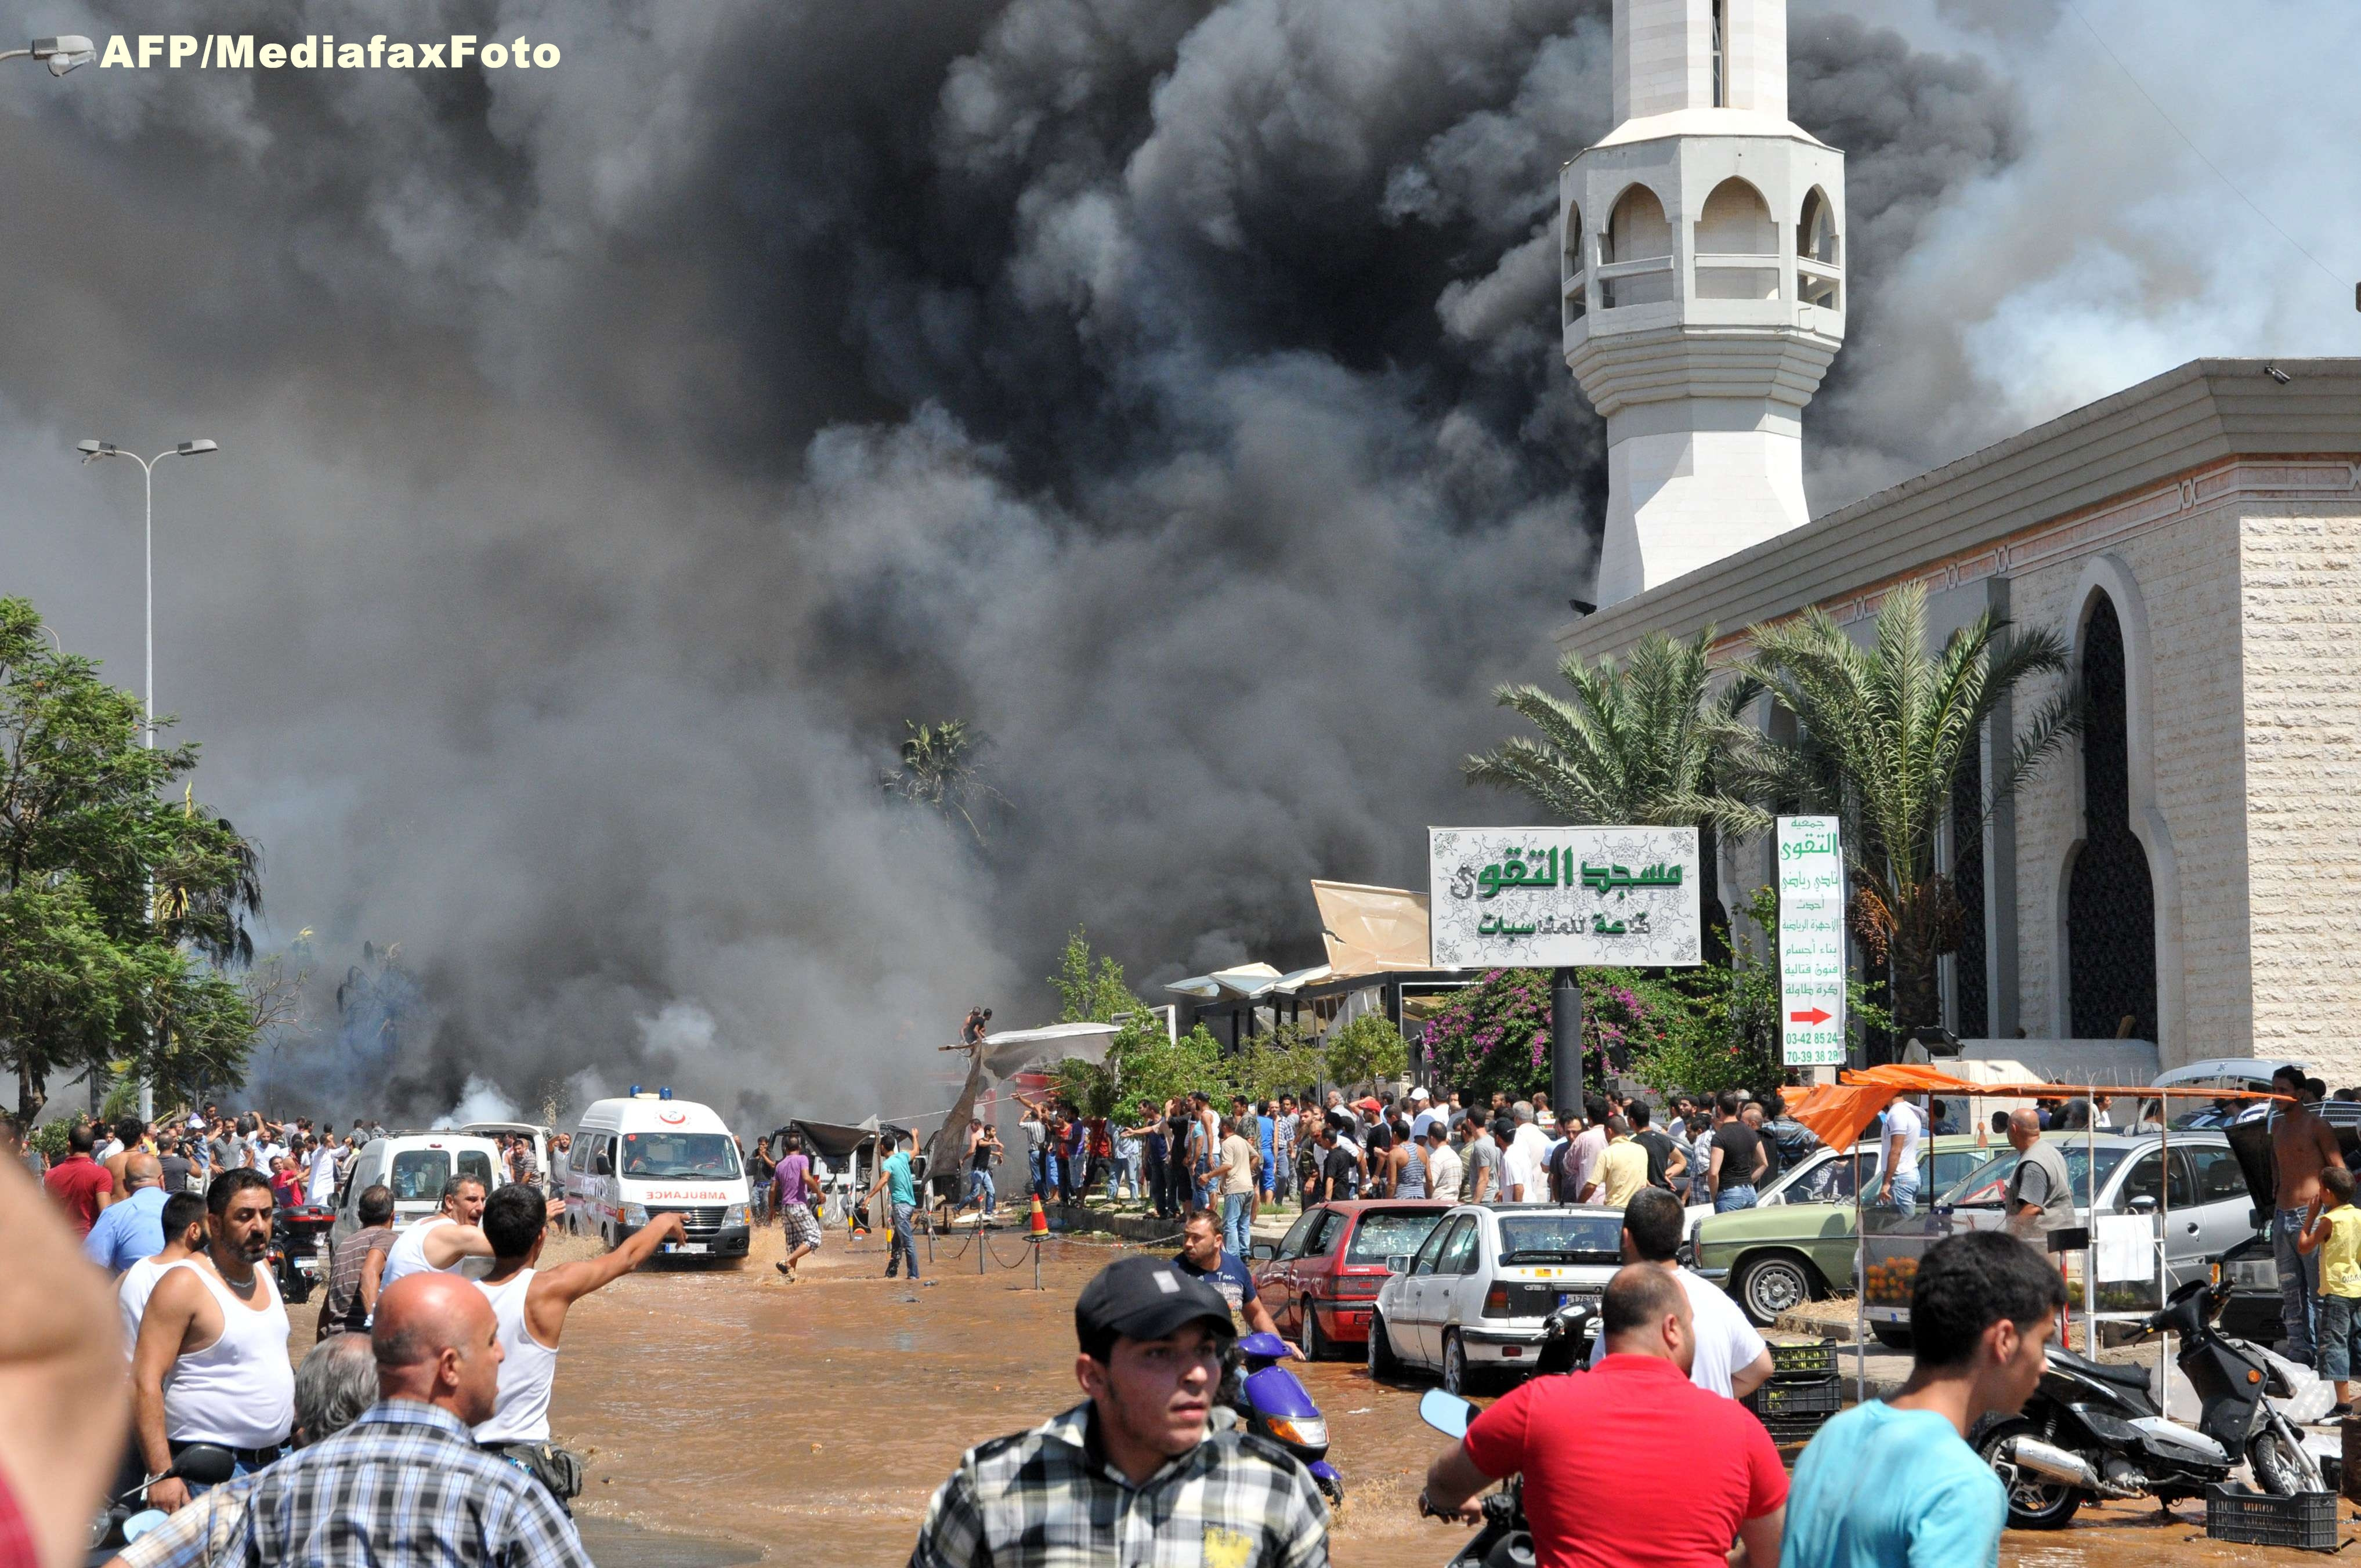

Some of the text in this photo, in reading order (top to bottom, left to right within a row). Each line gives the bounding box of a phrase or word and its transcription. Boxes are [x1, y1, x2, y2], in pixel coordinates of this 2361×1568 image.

[1791, 817, 1825, 830] جمعية
[1780, 832, 1837, 860] التقوى
[1582, 861, 1683, 899] مسجد
[1781, 871, 1838, 892] نادي رياضي
[1782, 918, 1809, 932] الرياضية
[1785, 939, 1837, 957] بناء أجسام
[1785, 963, 1838, 976] فنون قتالية
[1785, 983, 1838, 997] كرة طاولة
[1786, 1033, 1838, 1044] 03-42 85 24
[1787, 1051, 1839, 1063] 70-39 38 28
